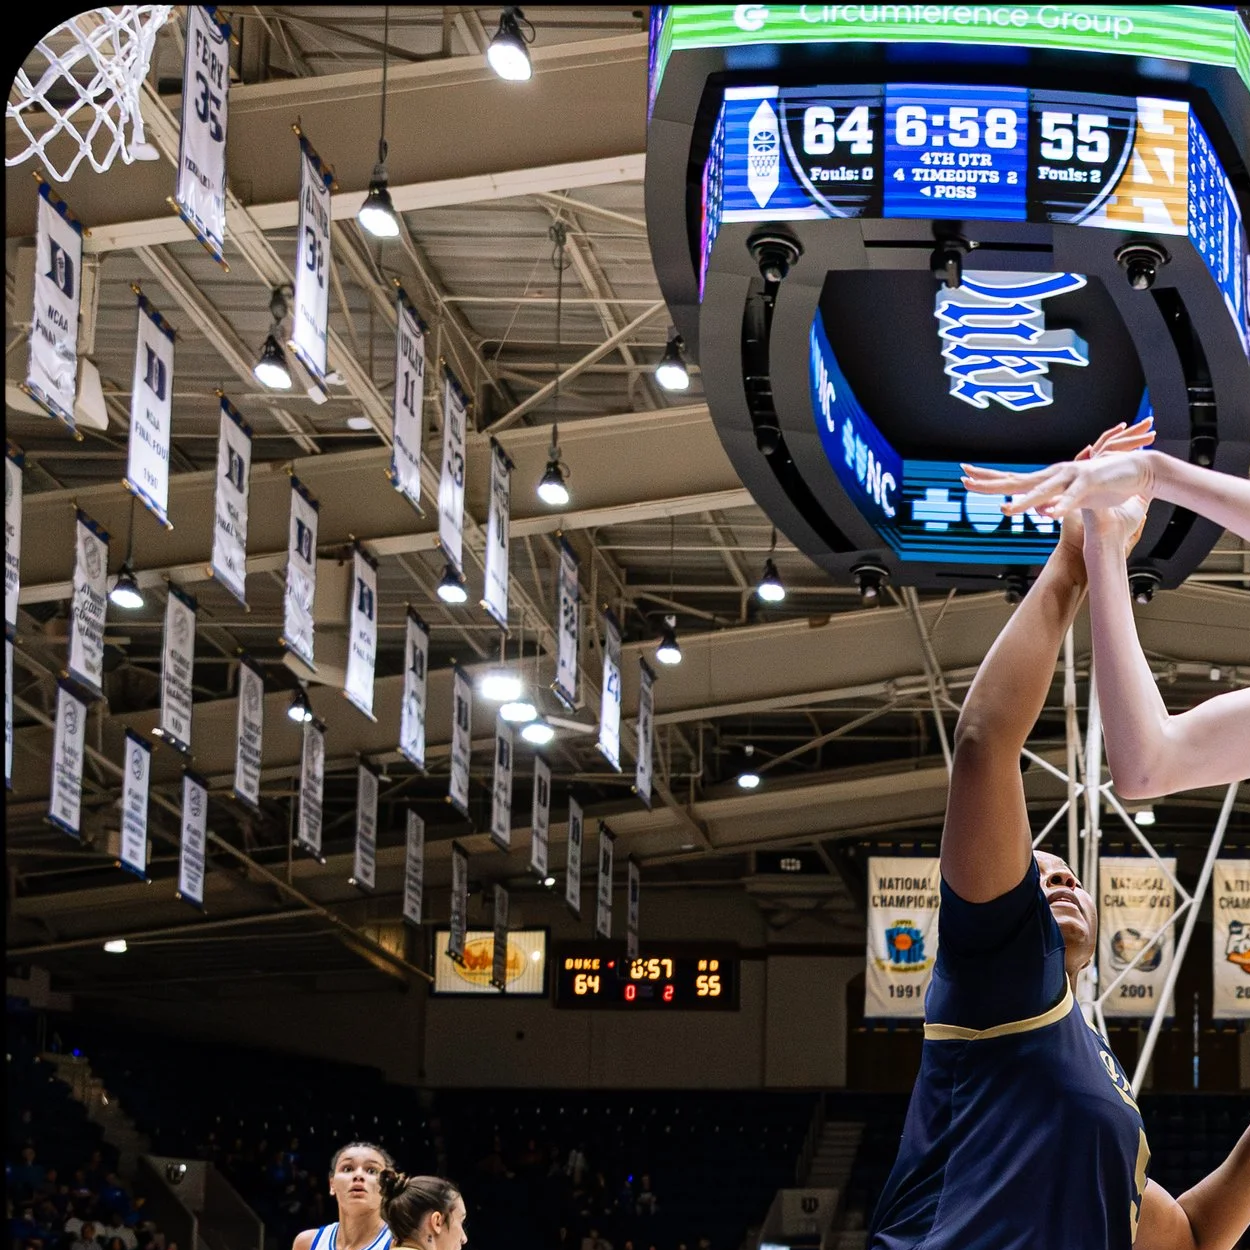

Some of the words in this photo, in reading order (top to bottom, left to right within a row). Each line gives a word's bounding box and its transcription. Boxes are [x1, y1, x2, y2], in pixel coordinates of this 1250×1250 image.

[1036, 6, 1133, 38] Group
[194, 70, 224, 143] 35
[803, 105, 874, 155] 64
[895, 105, 1018, 149] 6:58
[1040, 111, 1110, 163] 55
[920, 152, 955, 165] 4TH
[958, 153, 993, 167] QTR
[810, 167, 859, 181] Fouls:
[862, 167, 874, 181] 0
[893, 168, 905, 181] 4
[911, 168, 1000, 183] TIMEOUTS
[1006, 171, 1018, 184] 2
[1037, 166, 1087, 182] Fouls:
[1089, 169, 1102, 183] 2
[933, 185, 977, 199] POSS
[47, 304, 69, 333] NCAA
[403, 370, 415, 419] 11
[879, 877, 936, 891] NATIONAL
[872, 895, 940, 909] CHAMPIONS
[564, 958, 600, 970] DUKE
[574, 973, 600, 995] 64
[624, 984, 636, 1000] 0
[663, 984, 674, 1001] 2
[696, 975, 721, 996] 55
[888, 984, 922, 998] 1991
[1120, 985, 1154, 998] 2001
